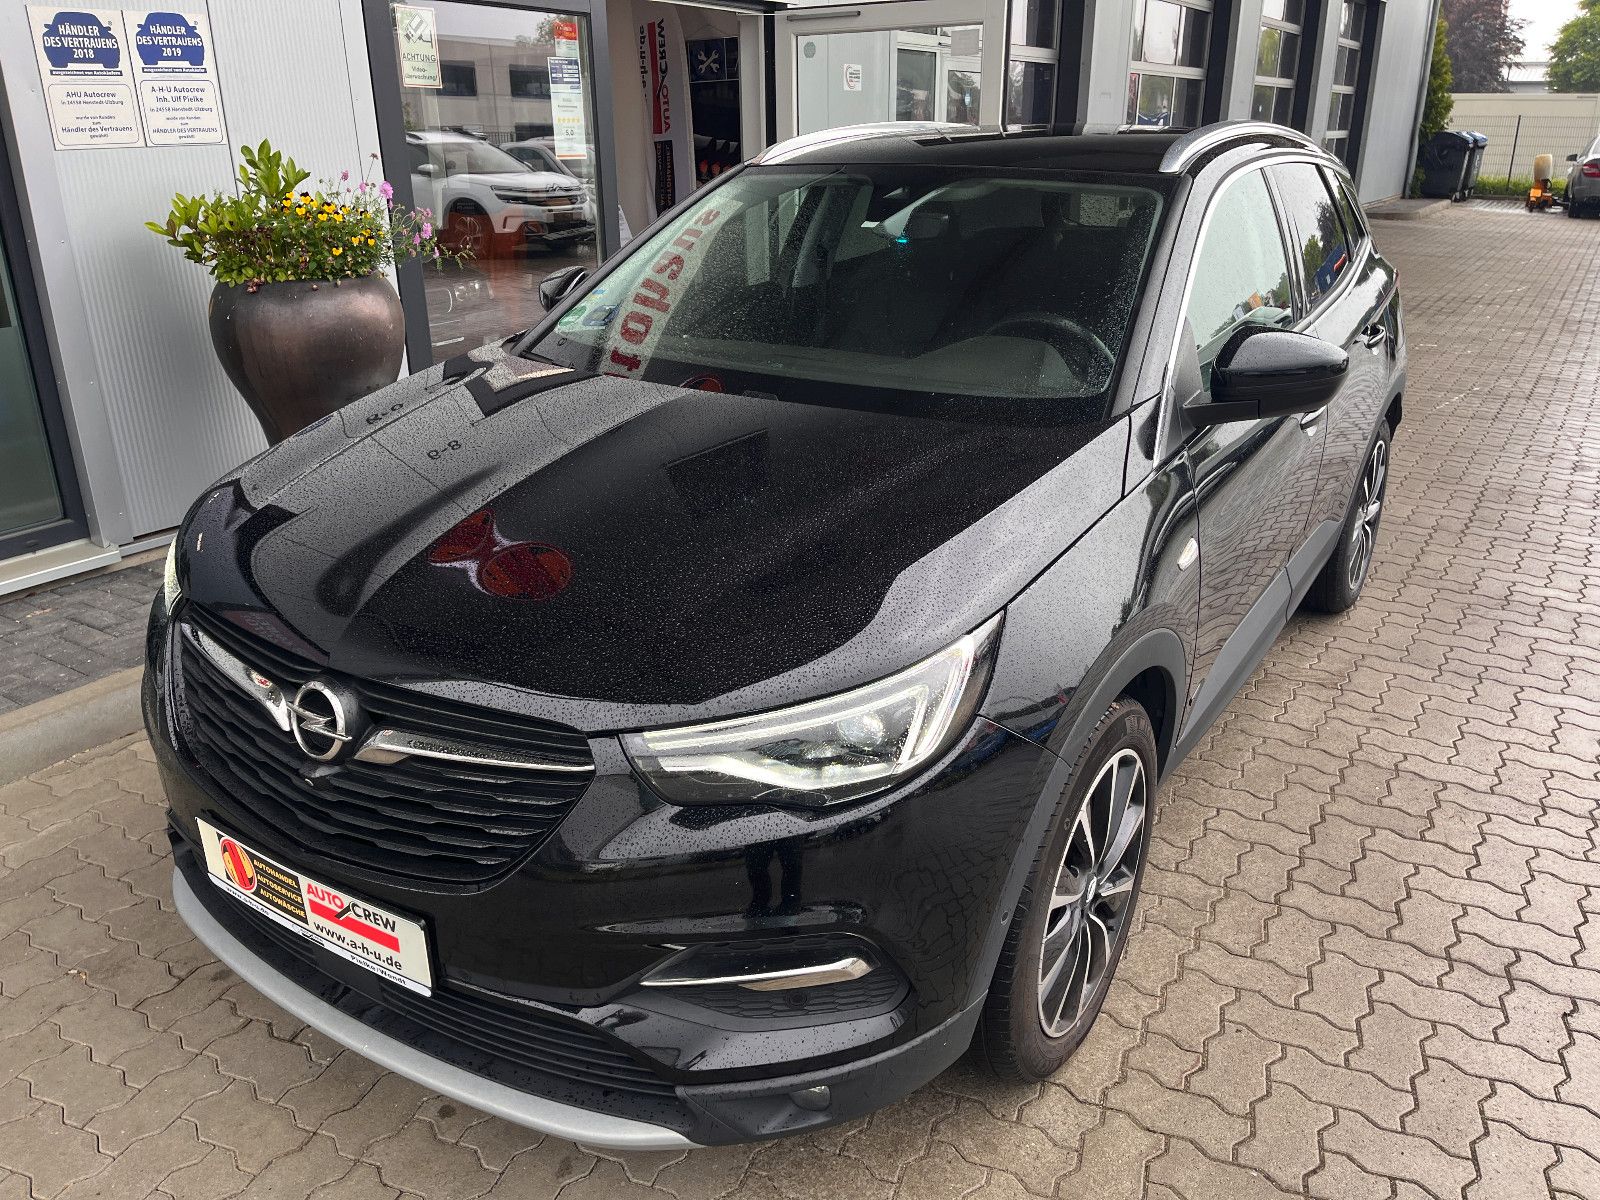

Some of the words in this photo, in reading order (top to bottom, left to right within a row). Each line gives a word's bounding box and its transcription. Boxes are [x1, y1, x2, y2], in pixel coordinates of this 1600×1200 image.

[58, 22, 100, 37] HÄNDLER
[149, 23, 187, 35] HÄNDLER
[44, 36, 62, 48] DES
[62, 37, 118, 49] VERTRAUENS
[136, 36, 153, 45] DES
[153, 36, 203, 47] VERTRAUENS
[73, 49, 95, 59] 2018
[162, 47, 182, 57] 2019
[402, 52, 437, 62] ACHTUNG
[171, 95, 182, 103] Ulf
[182, 95, 204, 103] Pielke
[253, 859, 299, 889] AUTOHANDEL
[256, 873, 303, 904] AUTOSERVICE
[260, 888, 307, 919] AUTOWÄSCHE
[306, 883, 345, 910] AUTO
[350, 902, 397, 933] CREW
[313, 921, 403, 971] www.a-h-u.de
